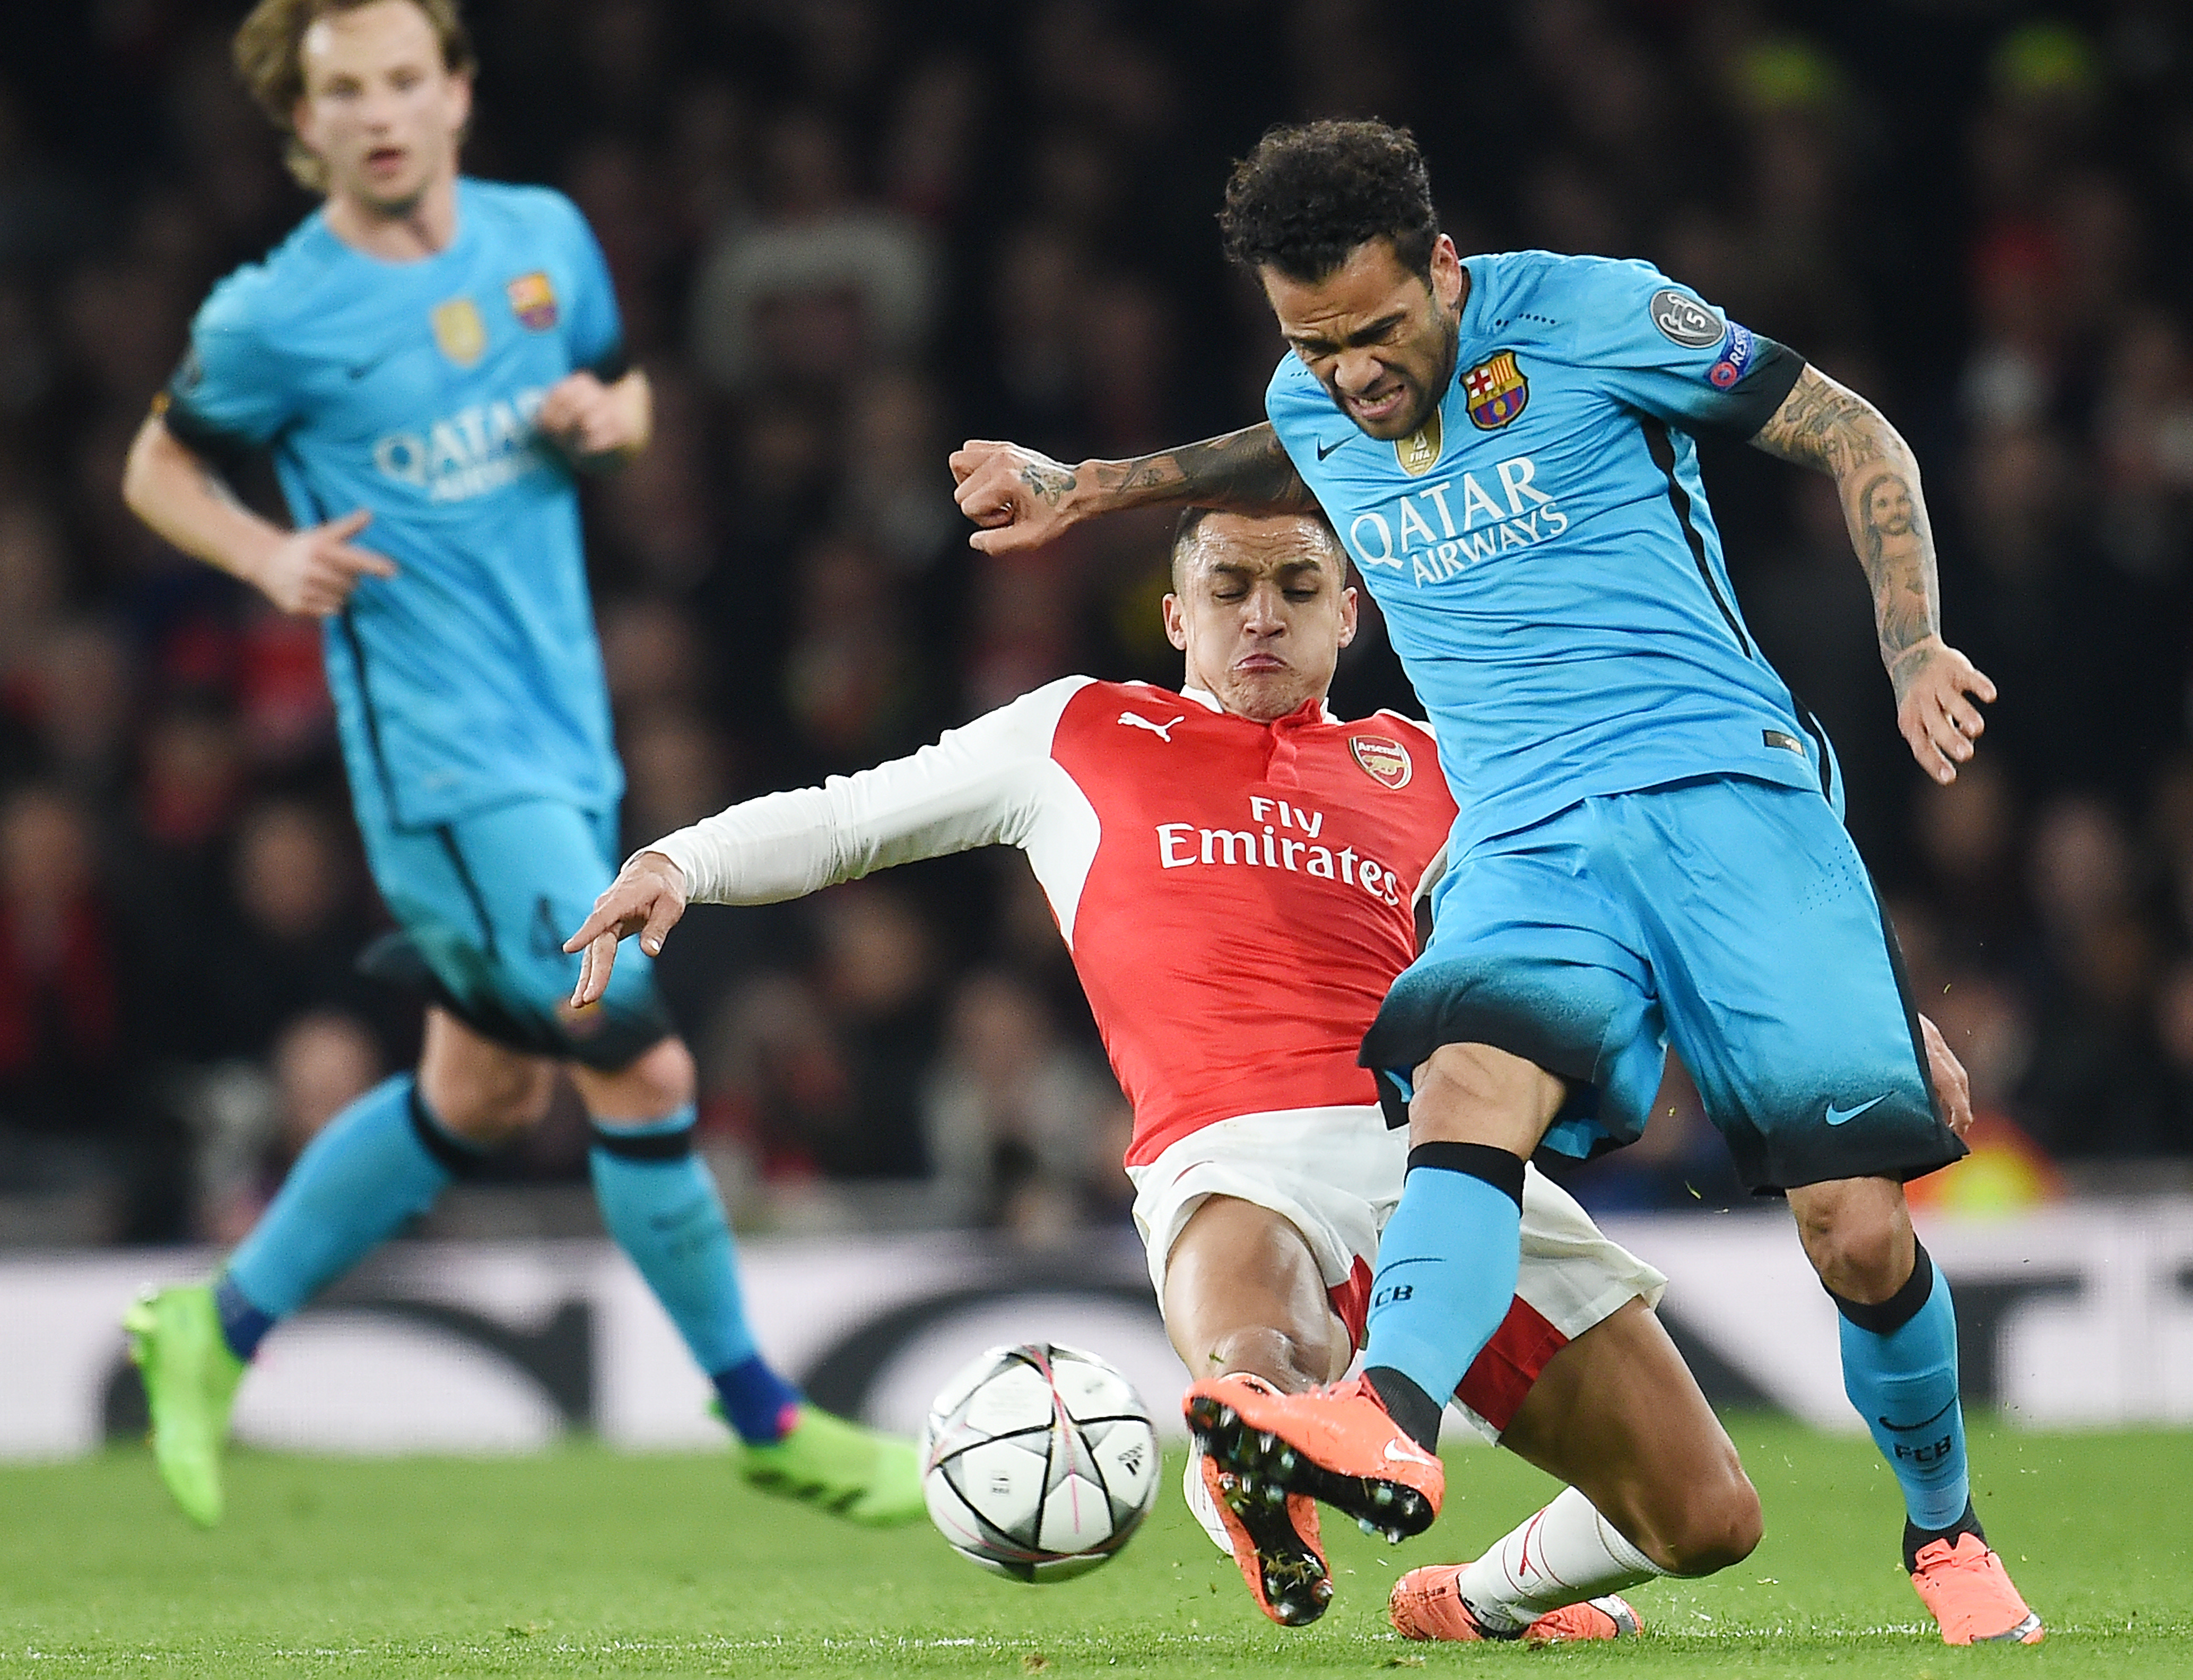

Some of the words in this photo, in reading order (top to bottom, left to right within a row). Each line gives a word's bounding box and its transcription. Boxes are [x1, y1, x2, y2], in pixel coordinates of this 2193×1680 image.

[1686, 311, 1706, 329] 5
[1409, 449, 1431, 463] FIFA
[1350, 457, 1553, 569] QATAR
[1411, 501, 1568, 589] AIRWAYS
[1358, 742, 1401, 757] Arsenal
[1249, 796, 1323, 838] Fly
[1155, 823, 1399, 906] Emirates
[1375, 1285, 1414, 1308] CB
[1894, 1435, 1951, 1461] FCB
